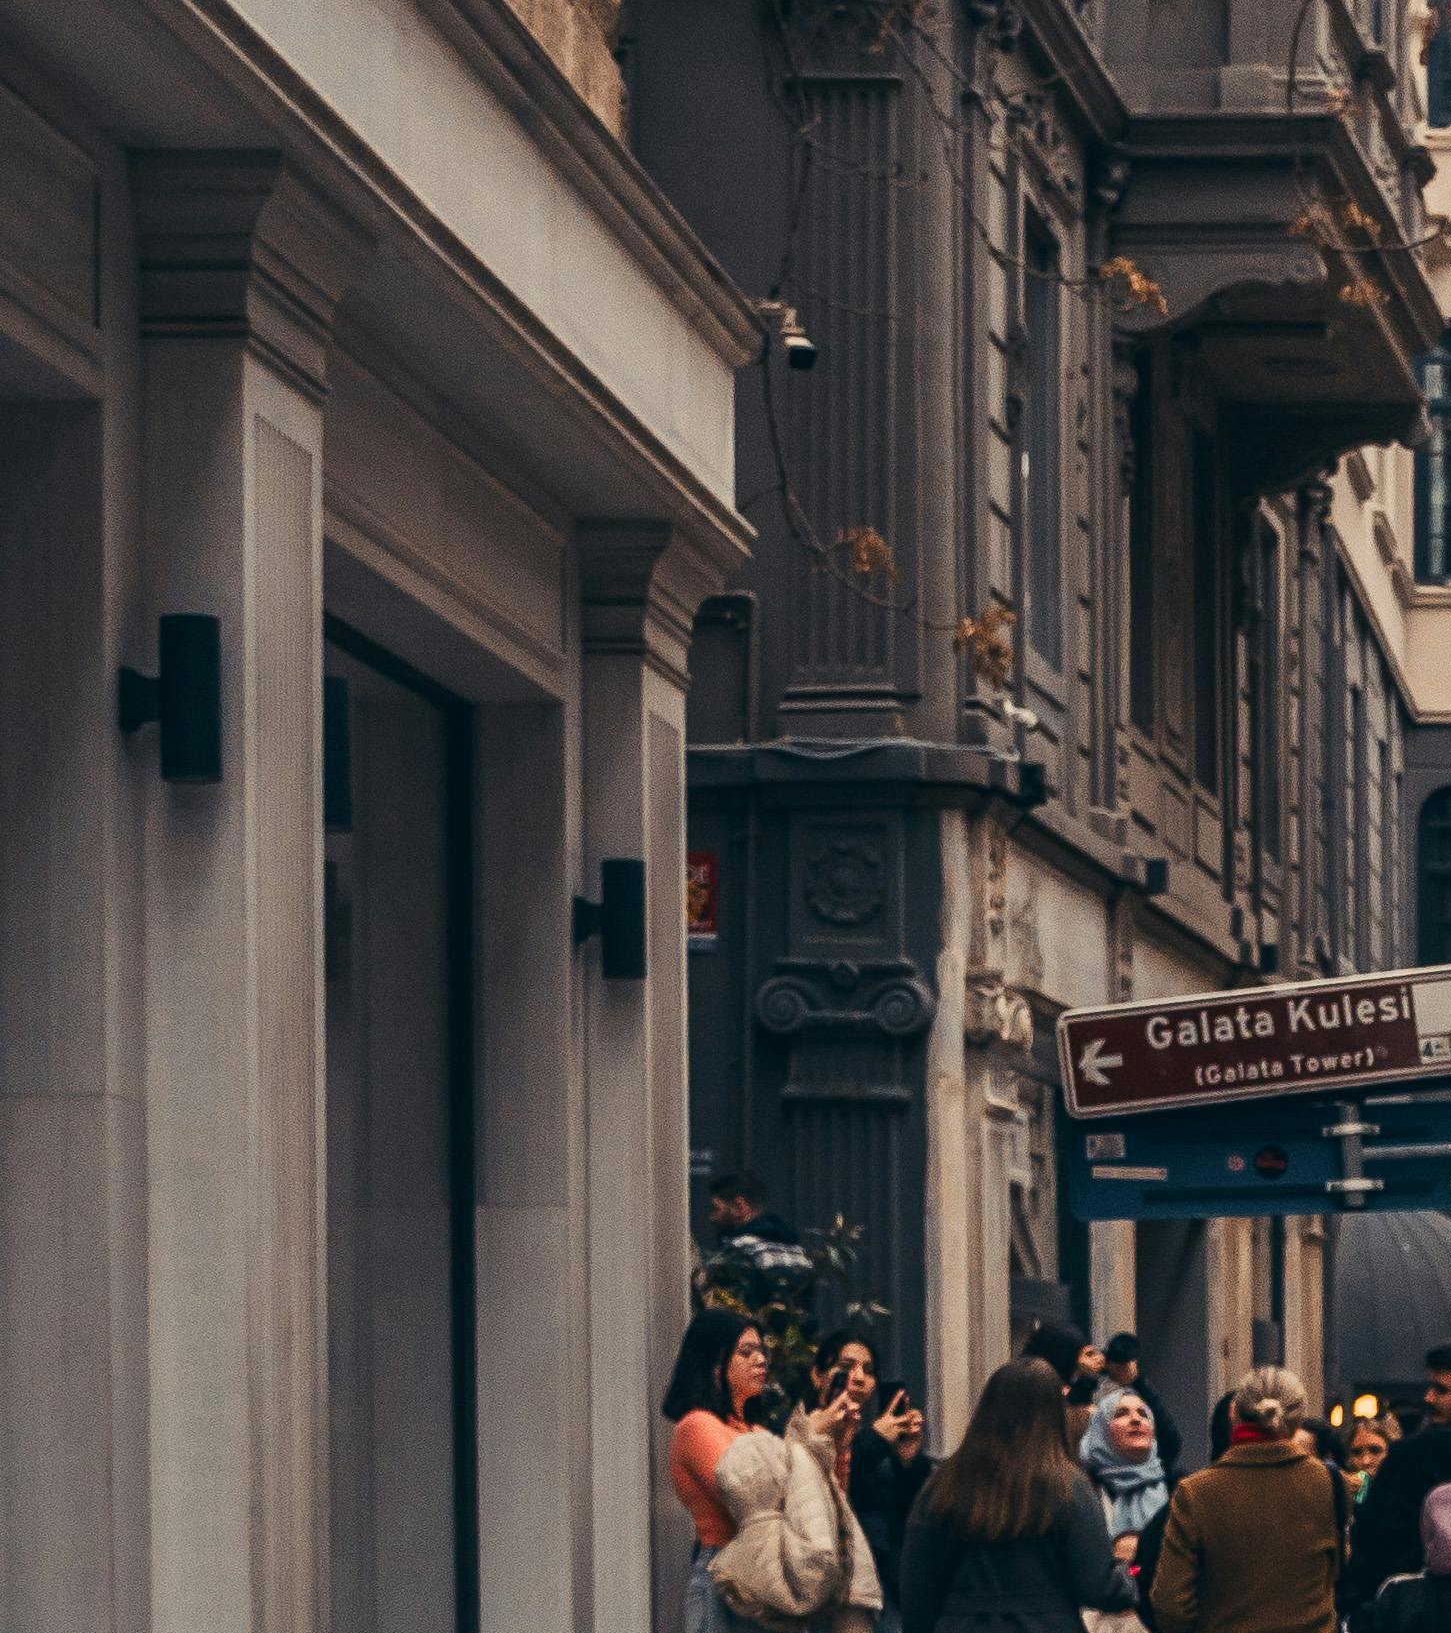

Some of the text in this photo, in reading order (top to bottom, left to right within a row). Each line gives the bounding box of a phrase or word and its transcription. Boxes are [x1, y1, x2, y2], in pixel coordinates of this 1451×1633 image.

[1145, 984, 1411, 1050] Galata Kulesi
[1194, 1047, 1375, 1086] (Galata Tower)
